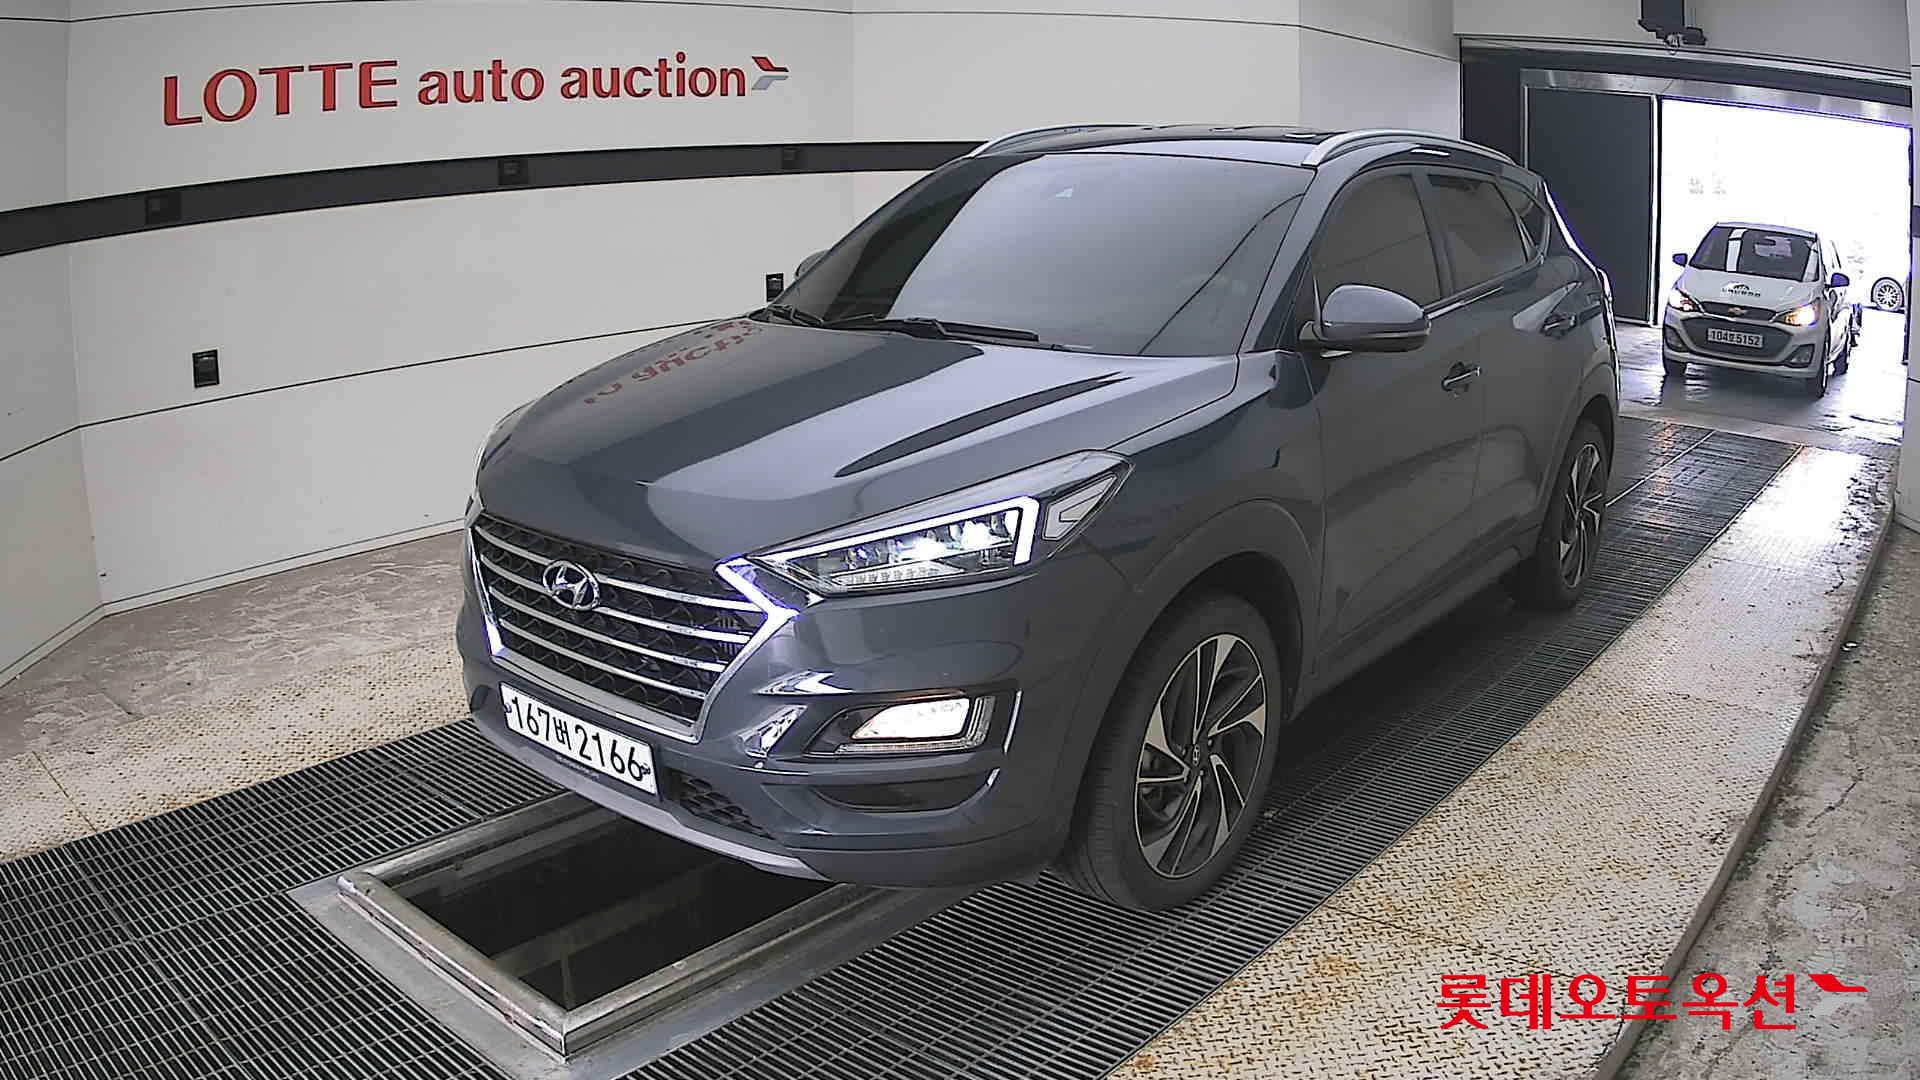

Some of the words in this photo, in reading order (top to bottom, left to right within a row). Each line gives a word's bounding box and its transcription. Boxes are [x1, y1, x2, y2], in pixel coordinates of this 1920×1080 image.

[162, 60, 399, 126] LOTTE
[418, 58, 545, 106] auto
[559, 52, 747, 101] auction
